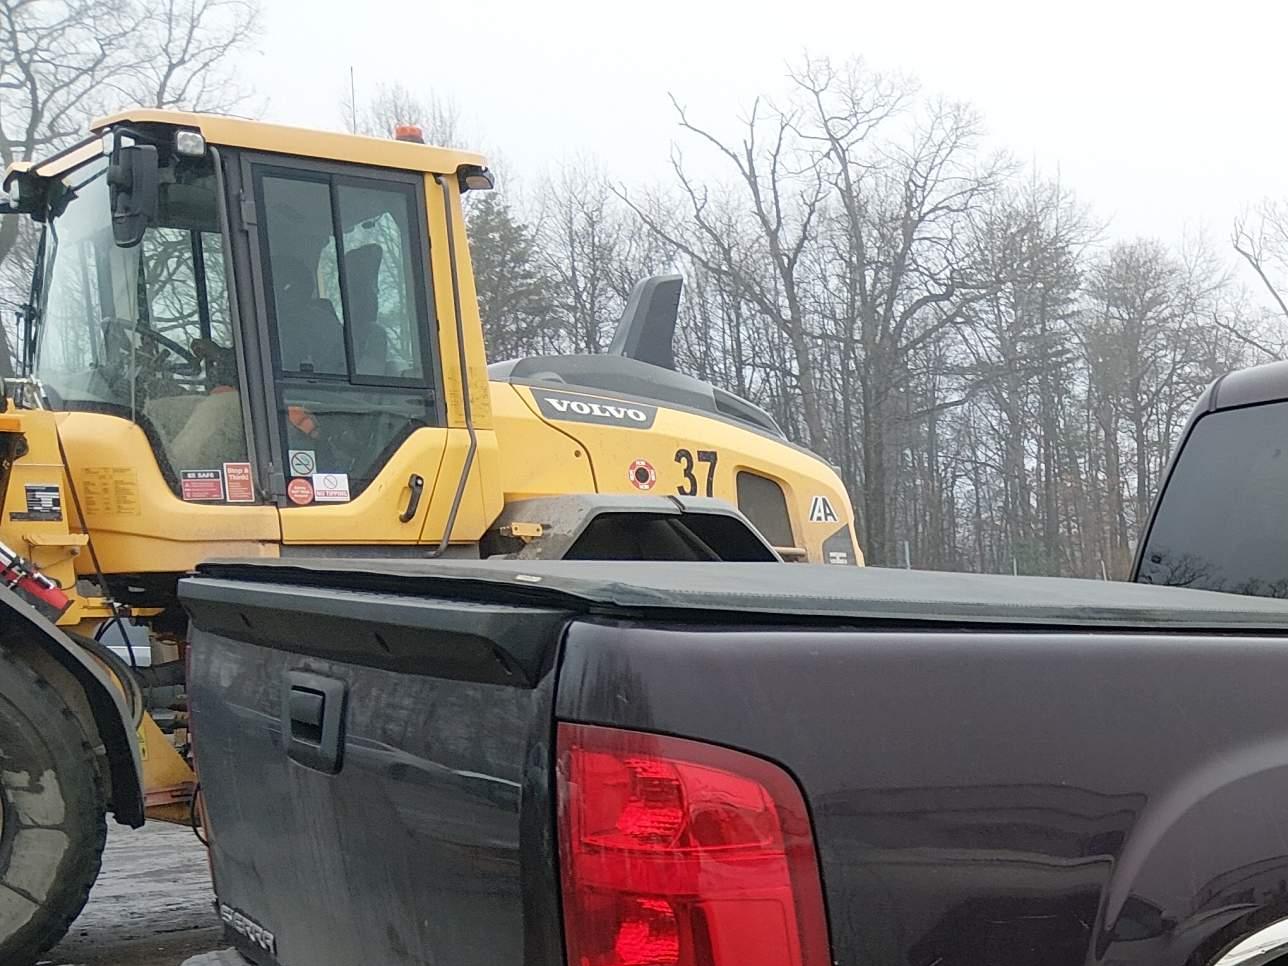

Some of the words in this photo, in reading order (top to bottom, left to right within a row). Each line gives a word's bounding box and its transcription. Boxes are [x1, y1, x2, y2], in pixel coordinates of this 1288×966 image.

[543, 397, 648, 422] VOLVO
[674, 448, 718, 498] 37
[220, 904, 275, 954] SIERRA
